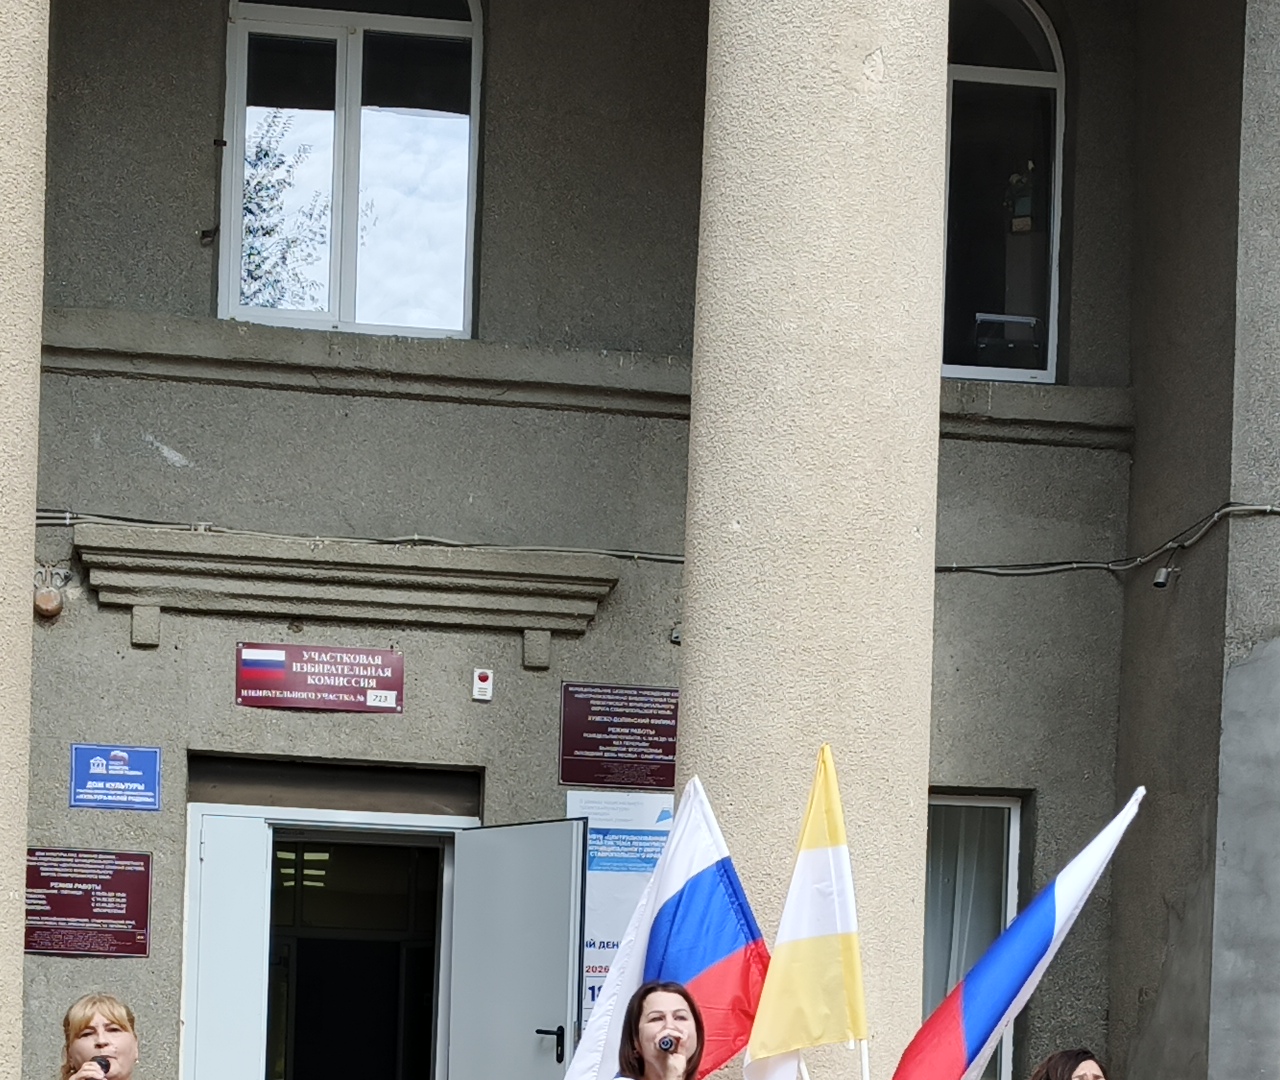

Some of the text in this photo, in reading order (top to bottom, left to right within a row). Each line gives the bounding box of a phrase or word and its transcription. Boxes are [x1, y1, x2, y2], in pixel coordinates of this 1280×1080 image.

[302, 650, 383, 665] УЧАСТКОВАЯ
[292, 662, 392, 678] ИЗБИРАТЕЛЬНАЯ
[307, 675, 377, 688] КОМИССИЯ
[316, 692, 355, 702] УЧАСТКА
[86, 780, 145, 790] ДОМ КУЛЬТУРЫ
